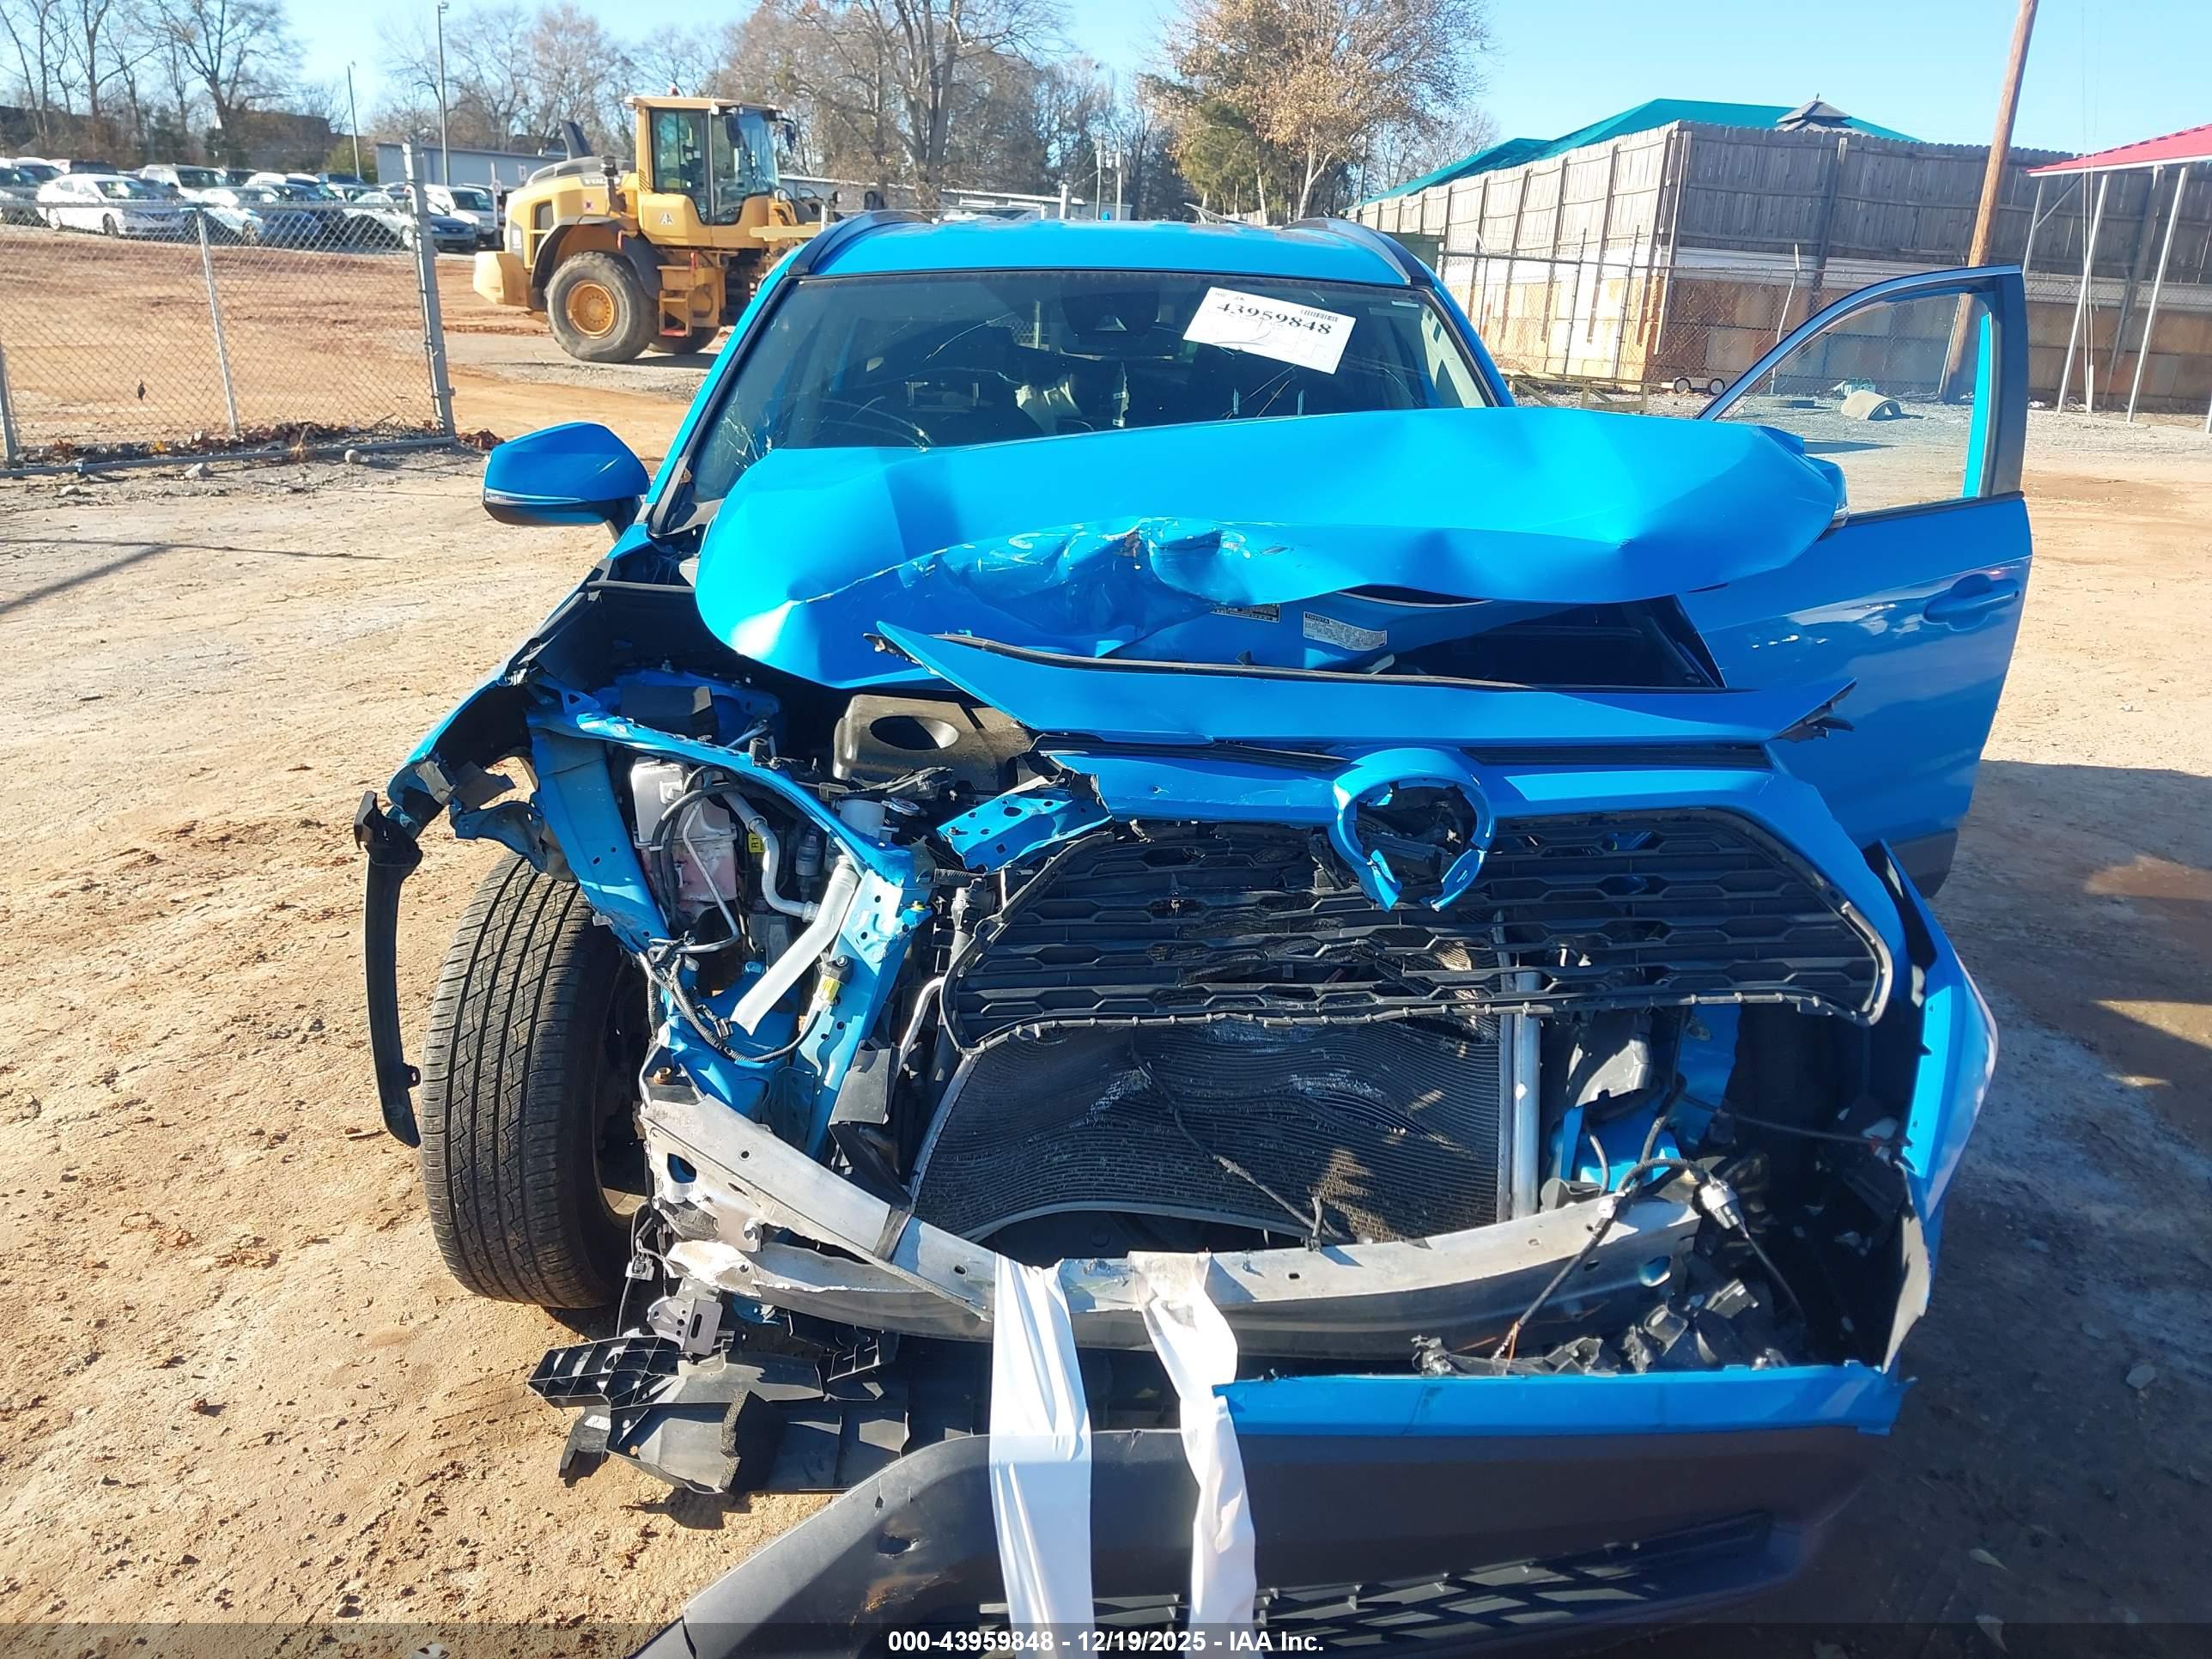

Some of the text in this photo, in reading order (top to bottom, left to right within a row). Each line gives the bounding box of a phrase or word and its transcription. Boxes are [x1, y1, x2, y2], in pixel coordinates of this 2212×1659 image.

[584, 176, 621, 185] VOLO
[1217, 302, 1333, 335] 43959848
[1306, 612, 1329, 624] TOYOTA
